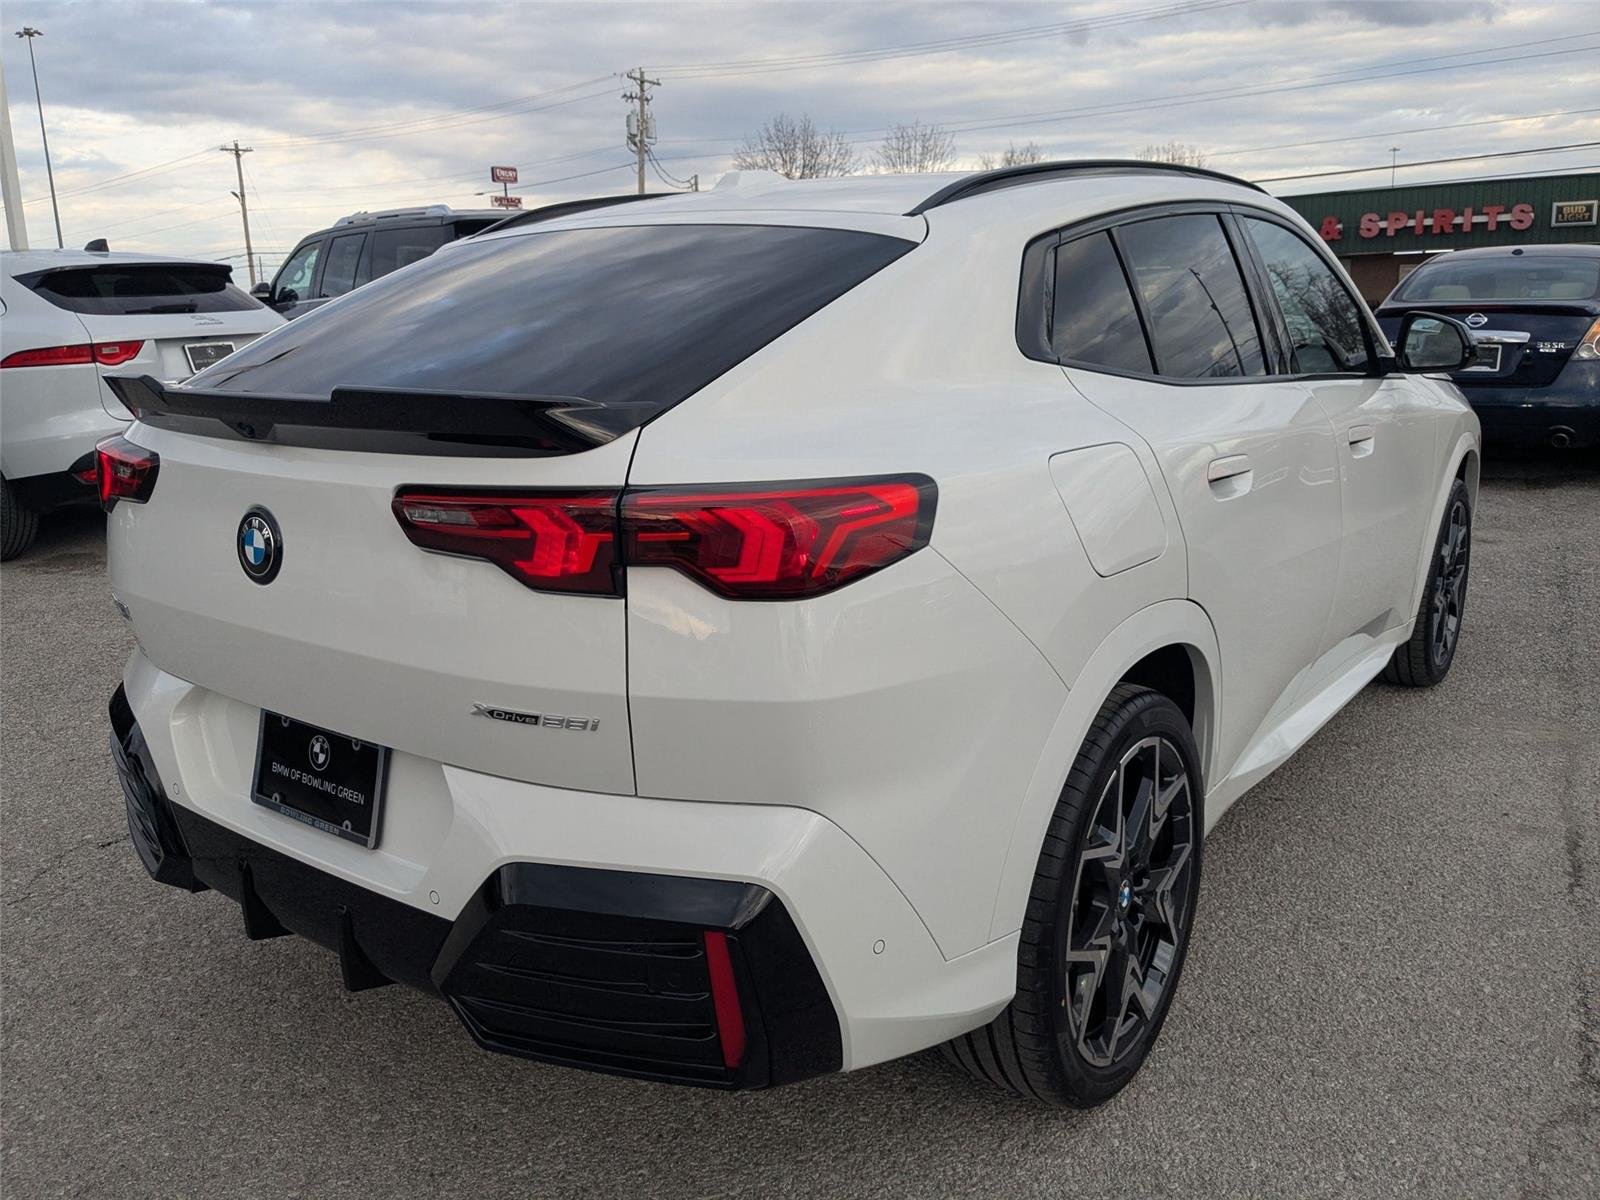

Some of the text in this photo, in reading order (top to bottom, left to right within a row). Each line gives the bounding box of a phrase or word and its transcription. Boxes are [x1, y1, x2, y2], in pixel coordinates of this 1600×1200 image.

[1319, 203, 1535, 241] & SPIRITS
[1558, 211, 1592, 221] LIGHT
[1562, 205, 1587, 214] BUD
[272, 762, 365, 805] BMW OF BOWLING GREEN
[280, 806, 340, 836] BOWLING GREEN
